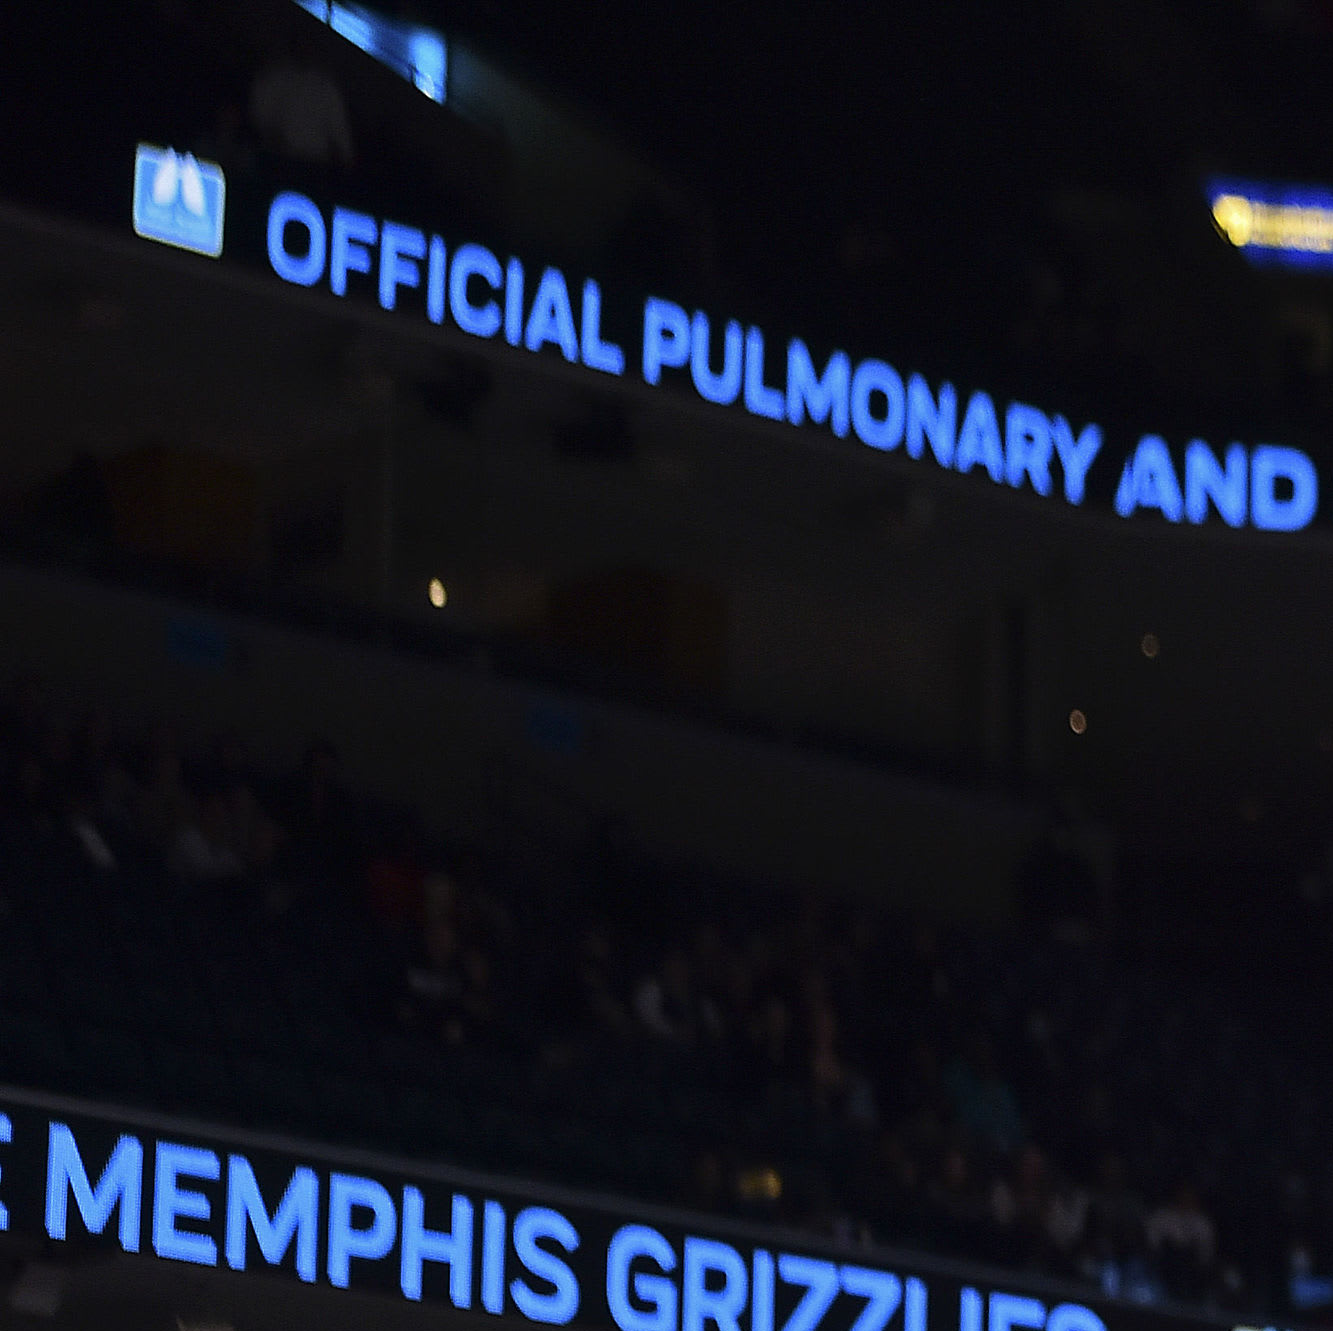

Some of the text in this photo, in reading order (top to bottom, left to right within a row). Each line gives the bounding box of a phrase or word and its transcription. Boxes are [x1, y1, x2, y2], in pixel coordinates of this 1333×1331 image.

[266, 190, 626, 376] OFFICIAL
[642, 296, 1103, 506] PULMONARY
[1113, 434, 1319, 533] AND
[44, 1121, 582, 1327] MEMPHIS
